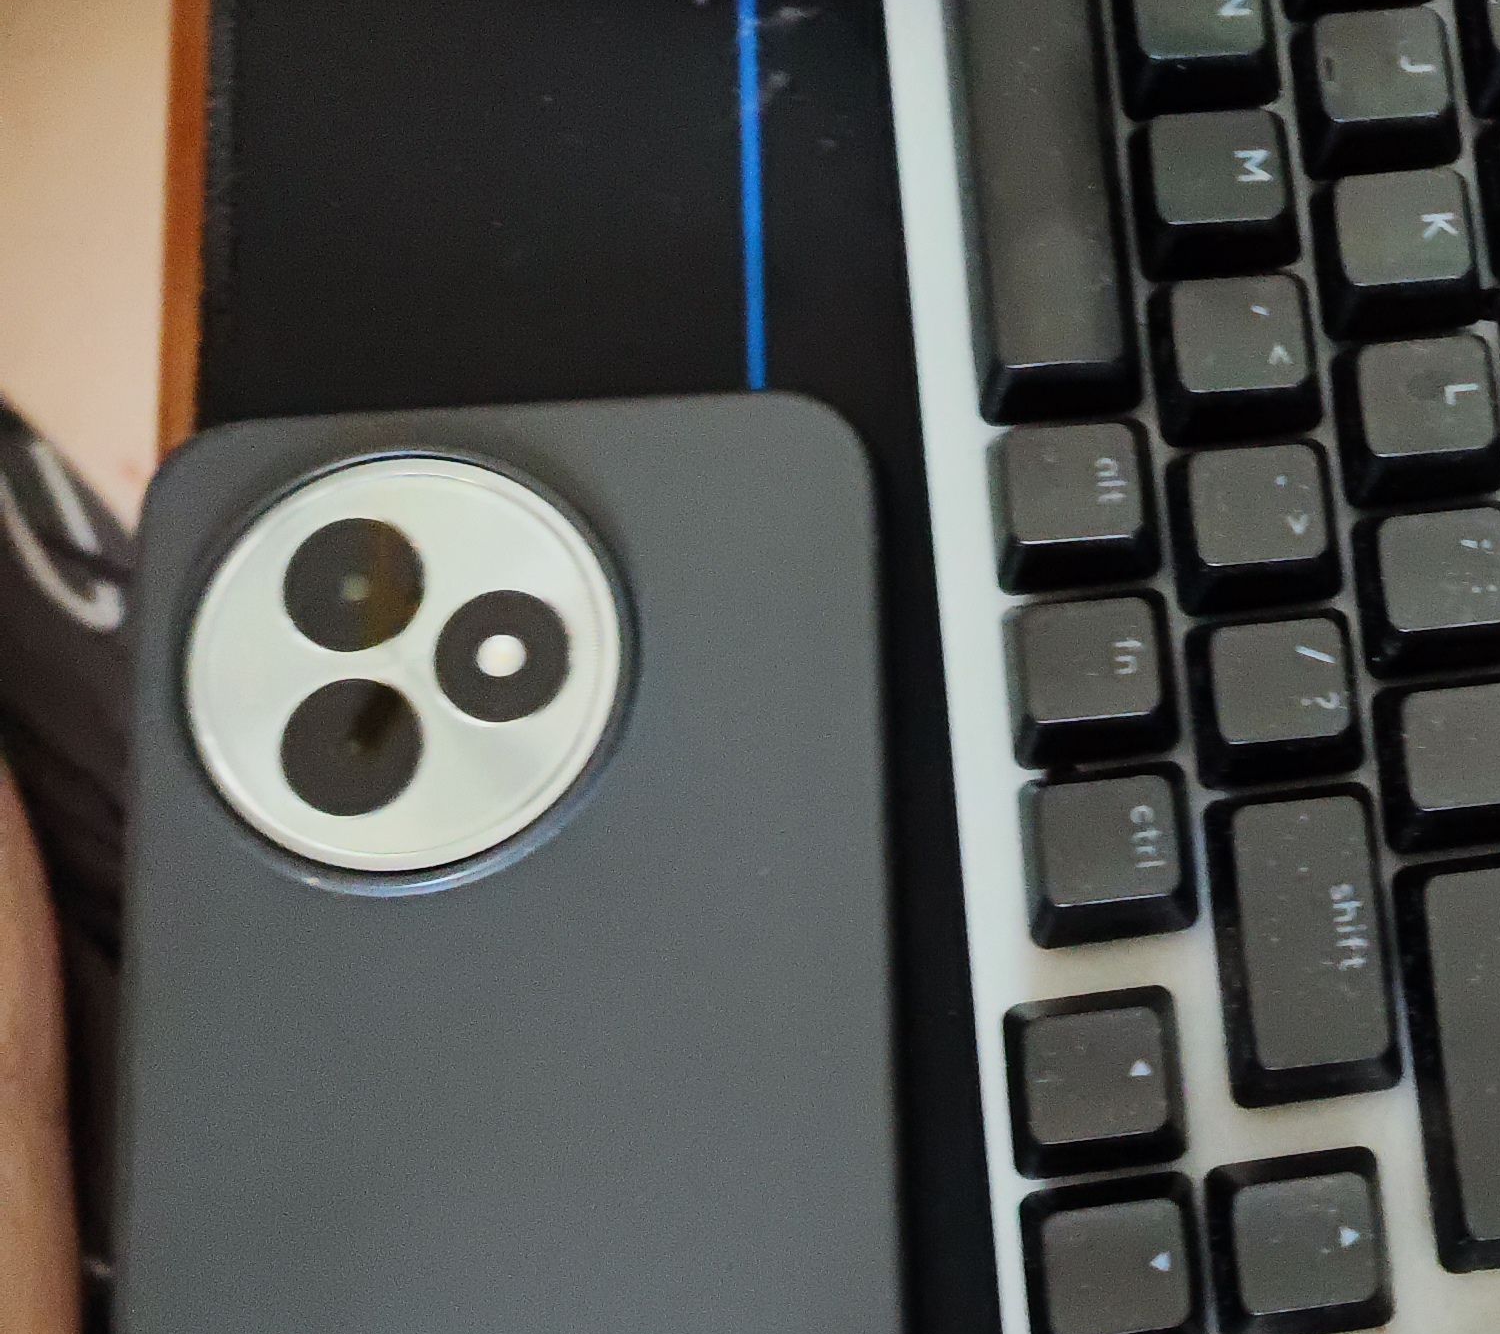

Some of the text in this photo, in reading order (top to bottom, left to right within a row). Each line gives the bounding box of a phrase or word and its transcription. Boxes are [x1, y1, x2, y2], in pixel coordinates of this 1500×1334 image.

[1400, 56, 1439, 74] J
[1234, 148, 1274, 184] M
[1421, 212, 1459, 240] K
[1443, 382, 1480, 406] L
[1094, 456, 1129, 503] alt
[1129, 804, 1168, 867] ctrl
[1329, 883, 1369, 971] shift
